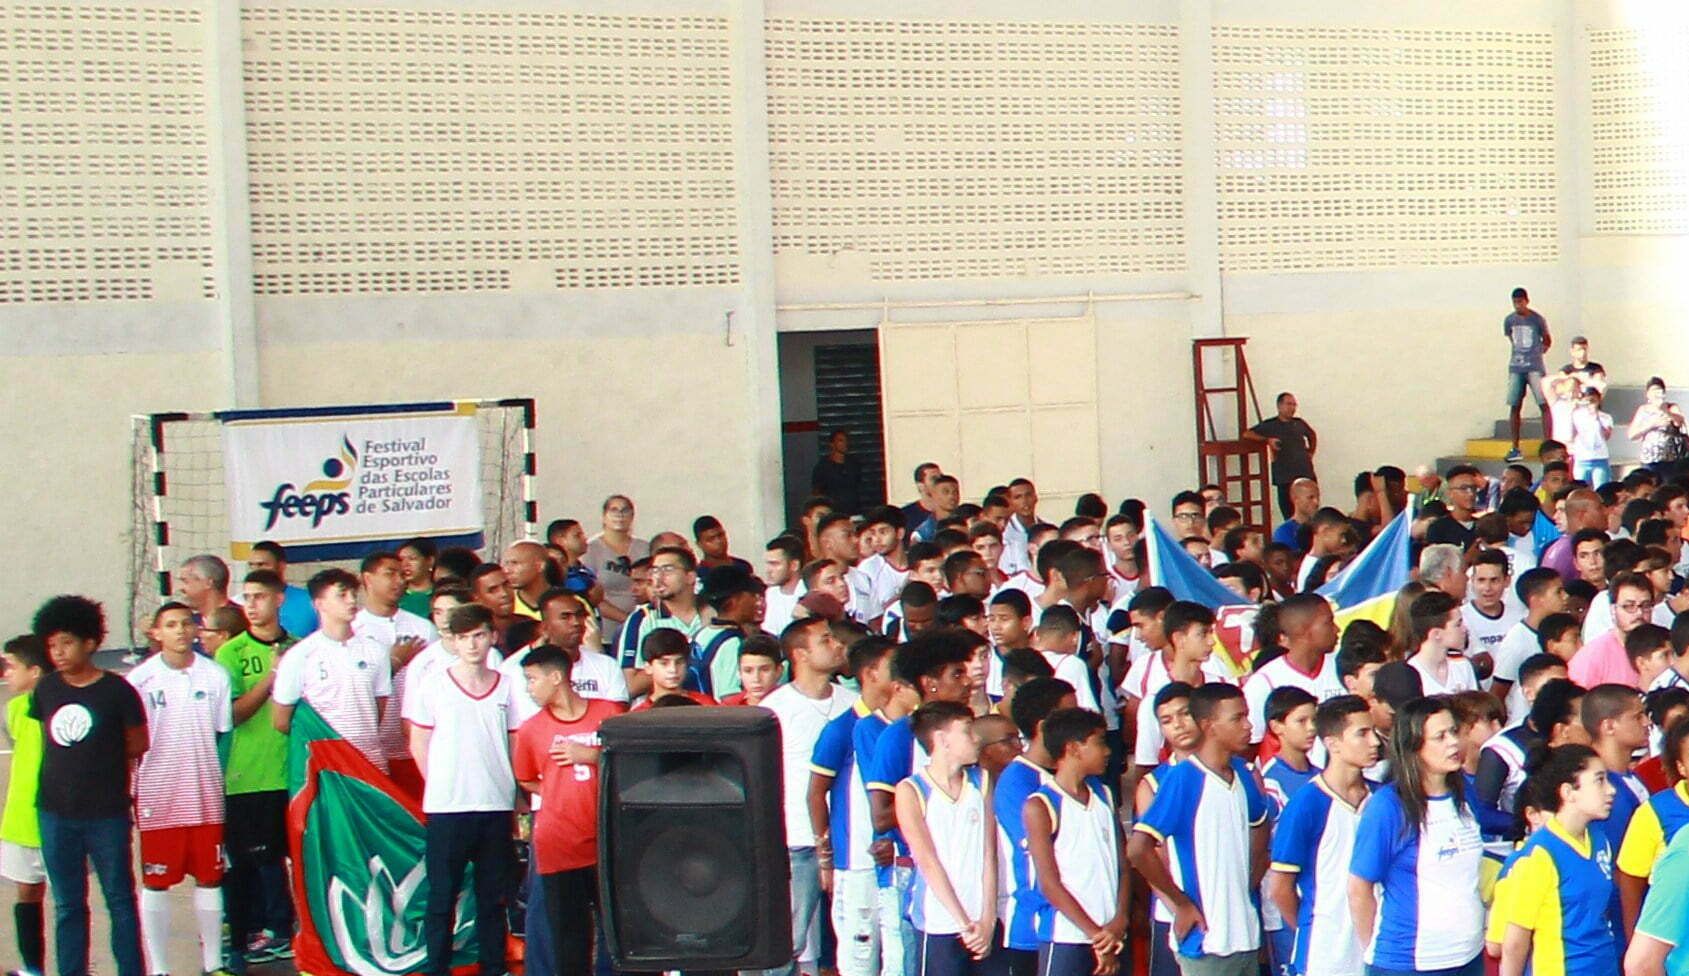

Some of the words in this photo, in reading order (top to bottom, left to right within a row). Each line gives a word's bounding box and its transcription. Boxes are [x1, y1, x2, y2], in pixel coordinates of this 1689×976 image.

[365, 437, 426, 454] Festival
[363, 453, 438, 470] Esportivo
[360, 471, 388, 484] das
[394, 467, 450, 483] Escolas
[358, 481, 453, 500] Particulares
[260, 483, 351, 532] feeps
[356, 500, 377, 514] de
[382, 496, 453, 513] Salvador
[240, 655, 263, 677] 20
[148, 690, 167, 710] 14
